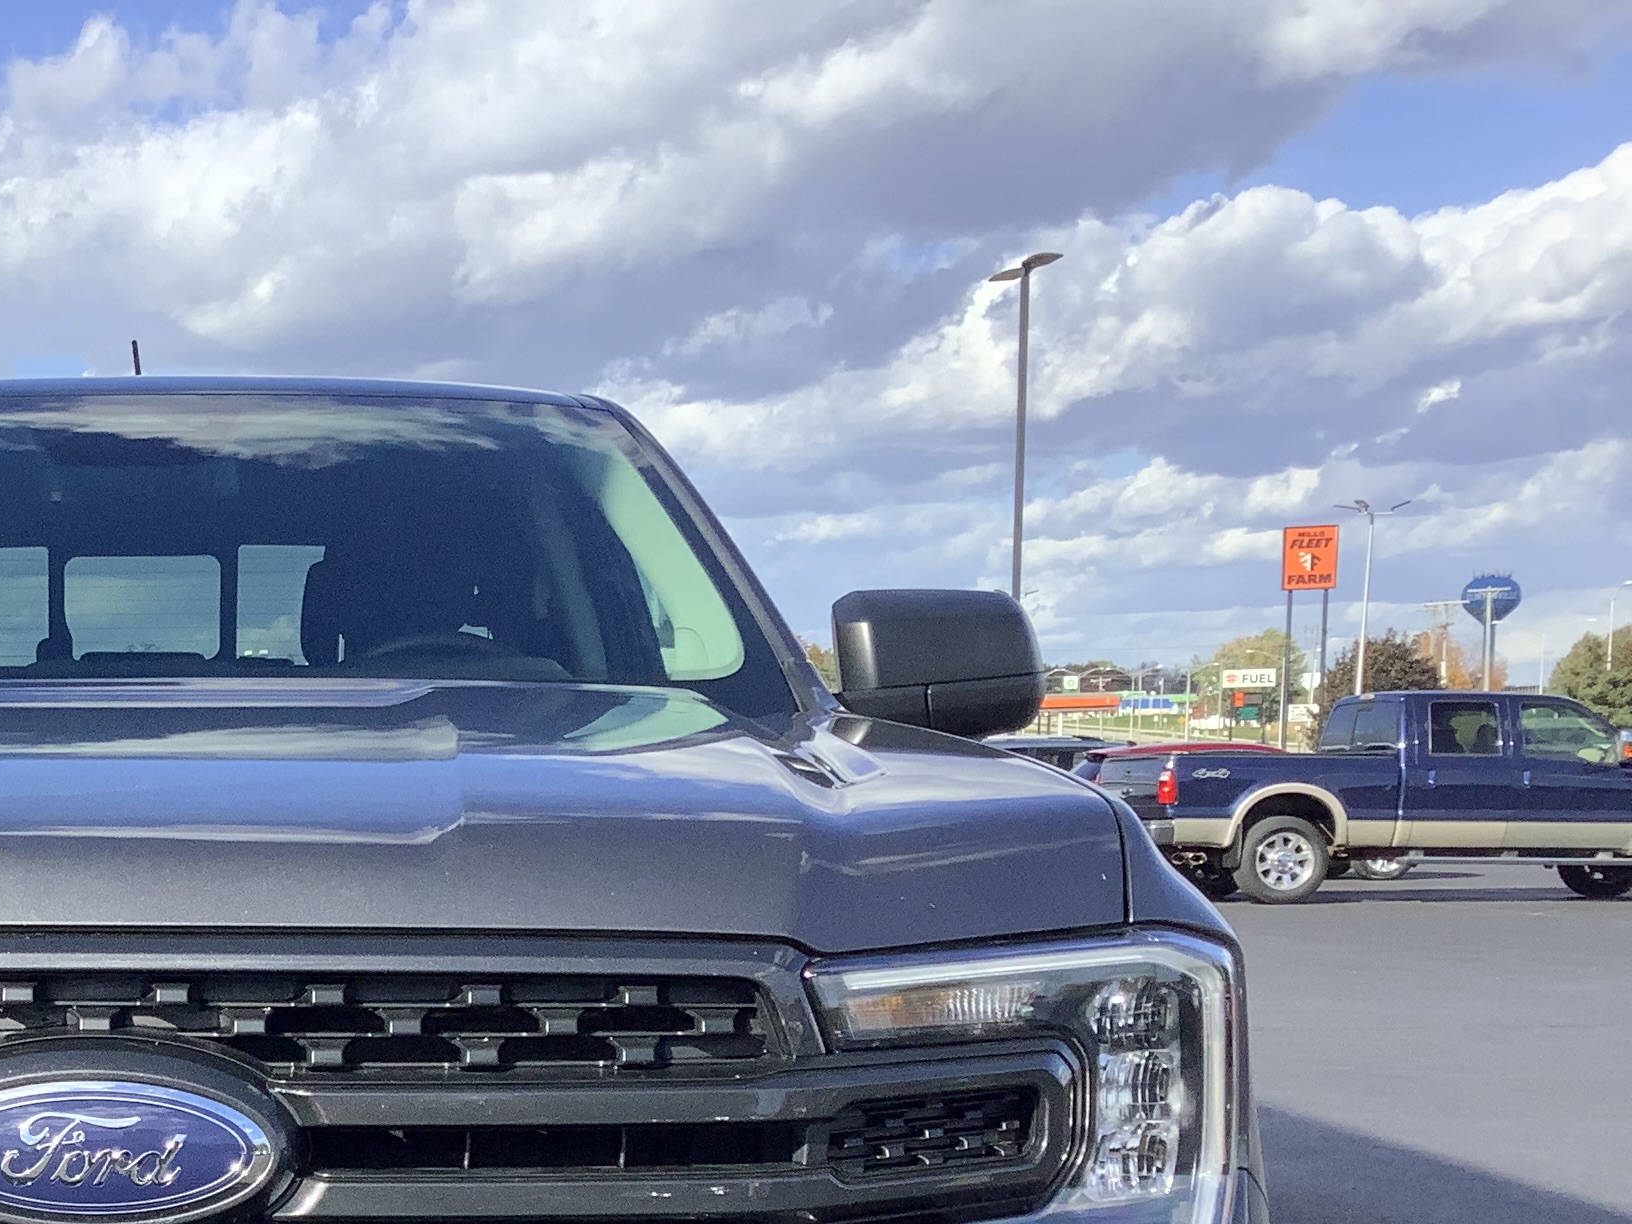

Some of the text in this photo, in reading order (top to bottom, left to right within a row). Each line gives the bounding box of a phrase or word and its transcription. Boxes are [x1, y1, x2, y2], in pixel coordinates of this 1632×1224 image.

[1289, 538, 1333, 549] FLEET
[1287, 573, 1332, 585] FARM
[1242, 673, 1274, 684] FUEL
[0, 1111, 188, 1187] Ford
